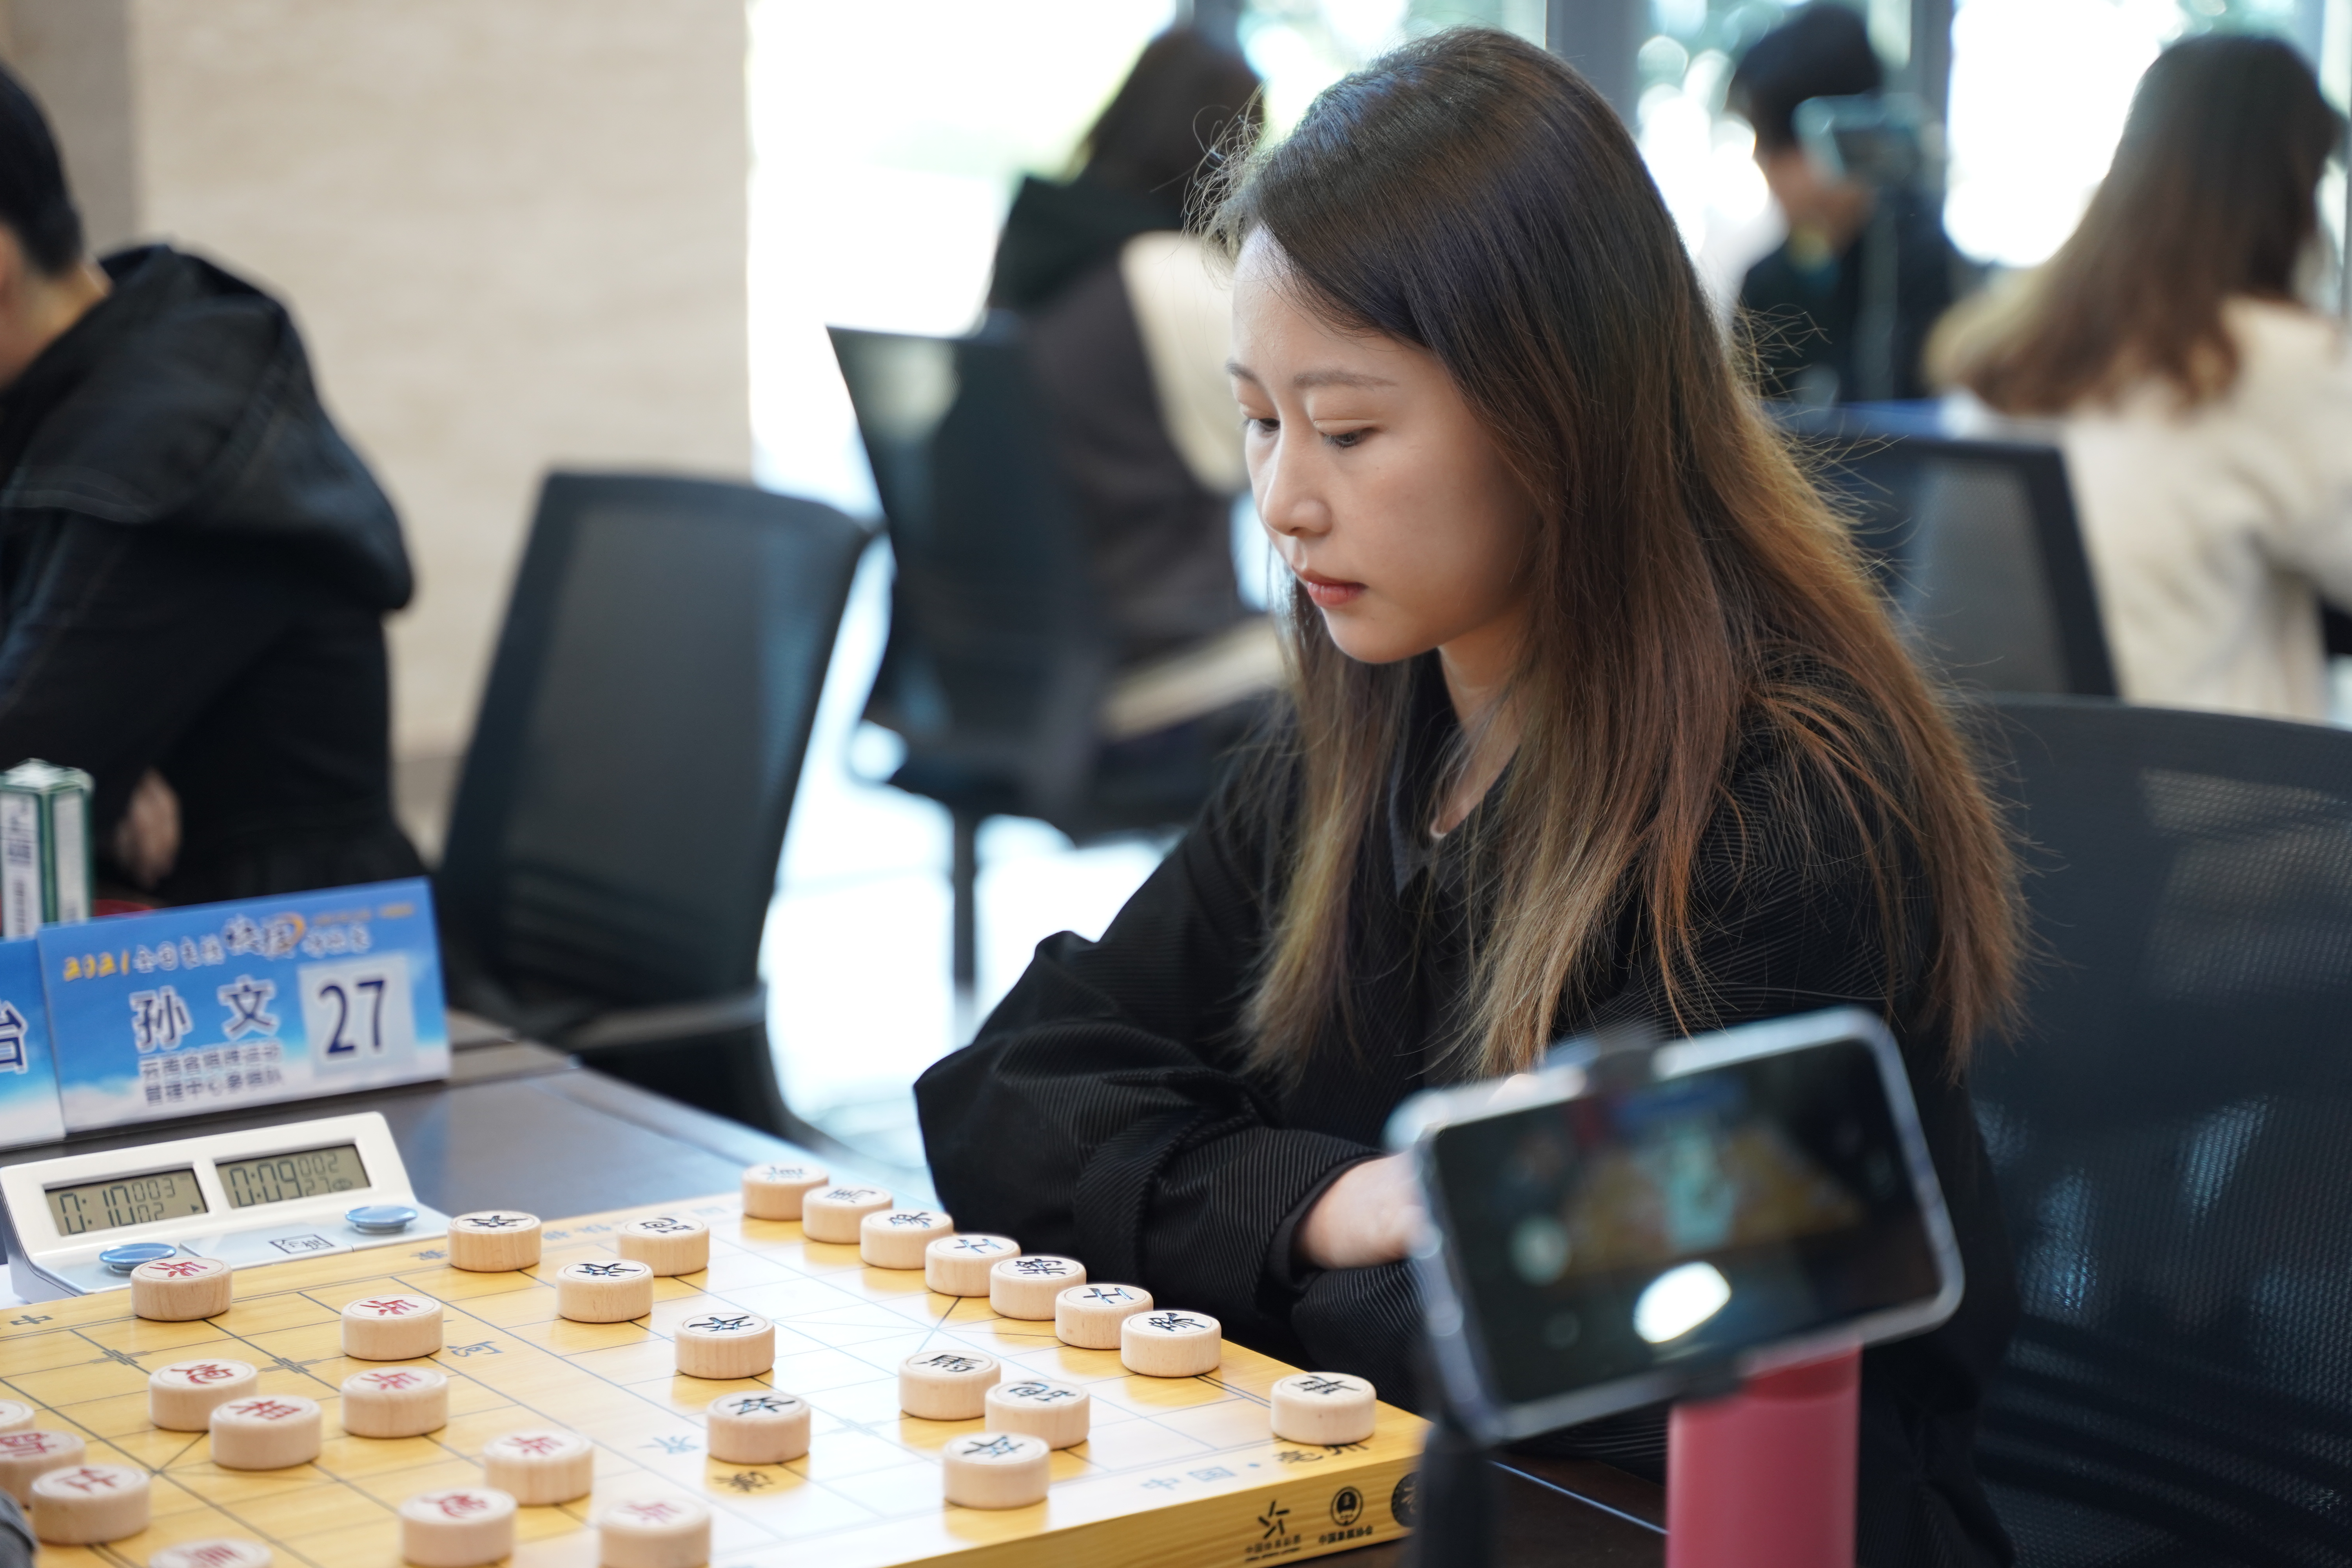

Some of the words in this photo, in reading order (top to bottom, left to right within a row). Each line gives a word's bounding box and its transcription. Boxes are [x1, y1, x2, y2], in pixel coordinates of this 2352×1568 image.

[319, 980, 384, 1054] 27
[230, 1159, 303, 1207] 0:09
[59, 1185, 137, 1234] 0:10
